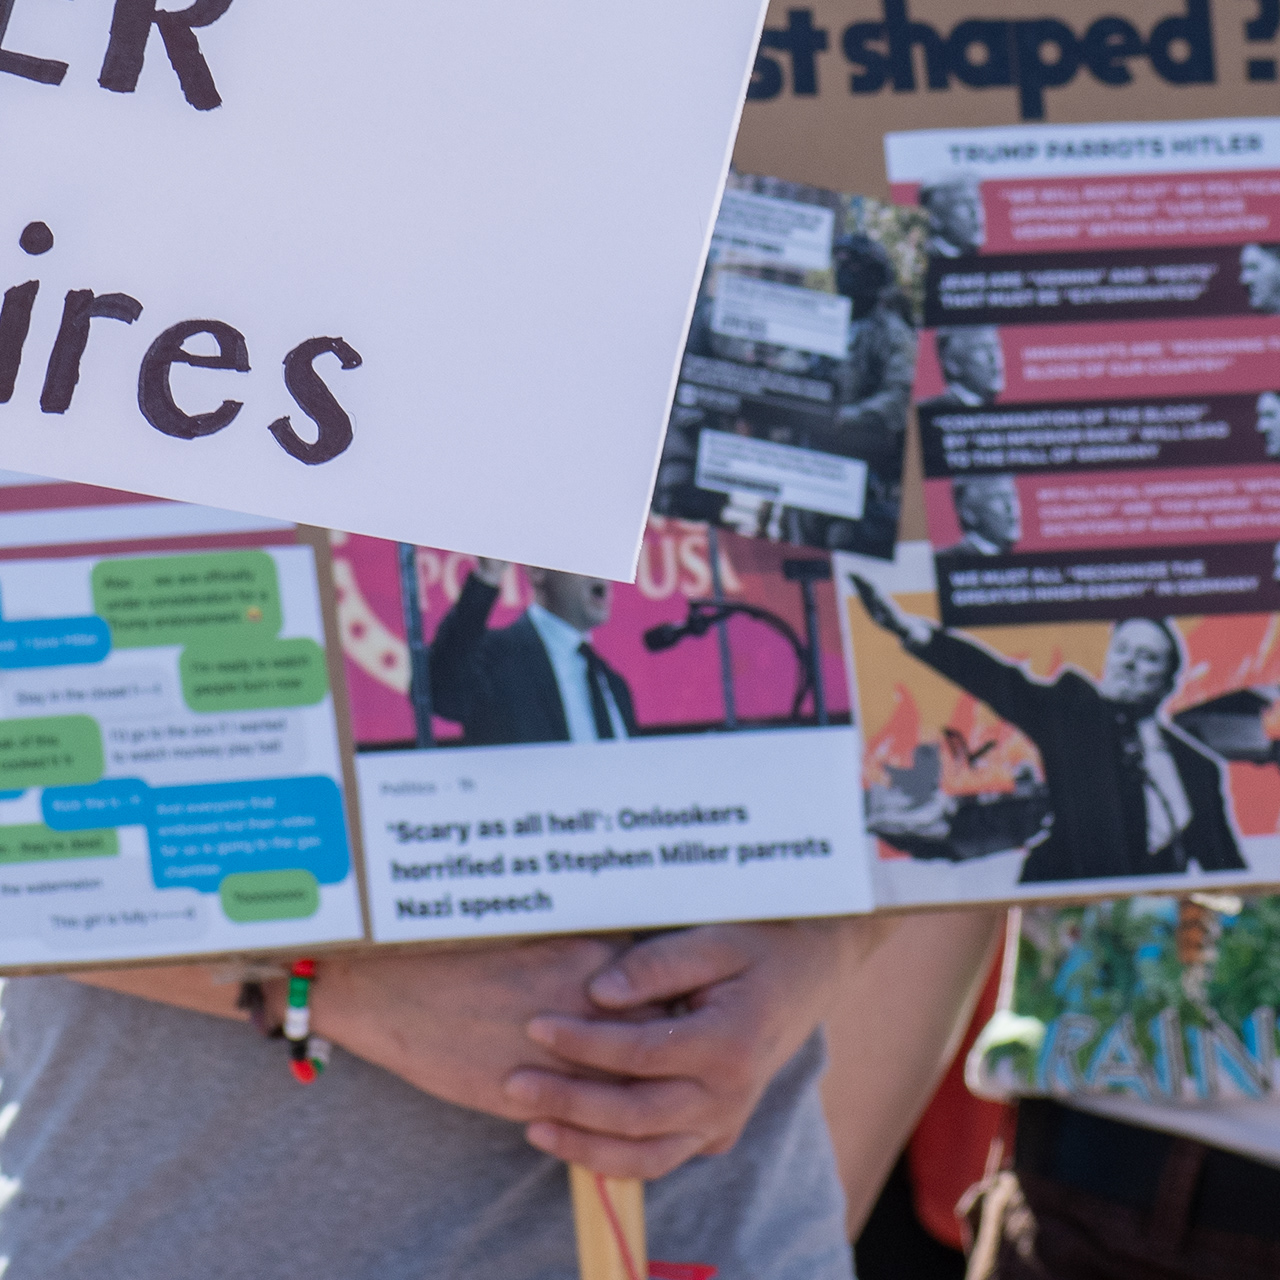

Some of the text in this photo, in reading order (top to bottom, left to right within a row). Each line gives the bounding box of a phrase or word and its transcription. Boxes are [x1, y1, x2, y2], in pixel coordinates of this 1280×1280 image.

[948, 135, 1263, 163] TRUMP PARROTS HITLER
[477, 821, 506, 838] as
[514, 814, 540, 836] all
[618, 804, 748, 831] Onlookers
[390, 839, 831, 880] horrified as Stephen Miller parrots
[395, 891, 553, 920] Nazi speech
